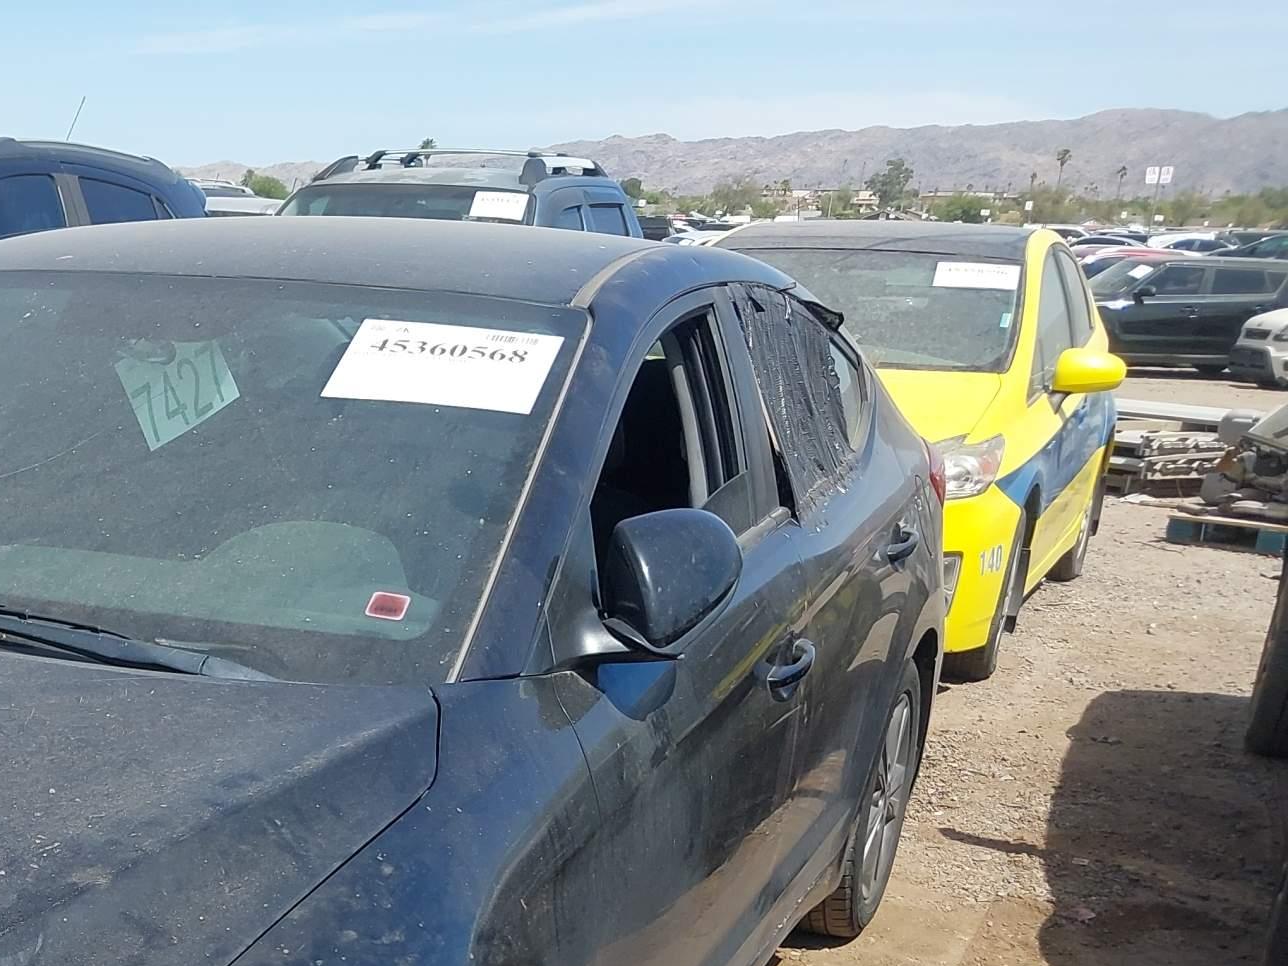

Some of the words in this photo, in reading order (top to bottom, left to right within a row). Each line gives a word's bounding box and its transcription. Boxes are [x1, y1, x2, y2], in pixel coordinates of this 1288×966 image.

[369, 337, 529, 364] 45360568
[130, 340, 226, 442] 7427
[980, 544, 1003, 576] 140
